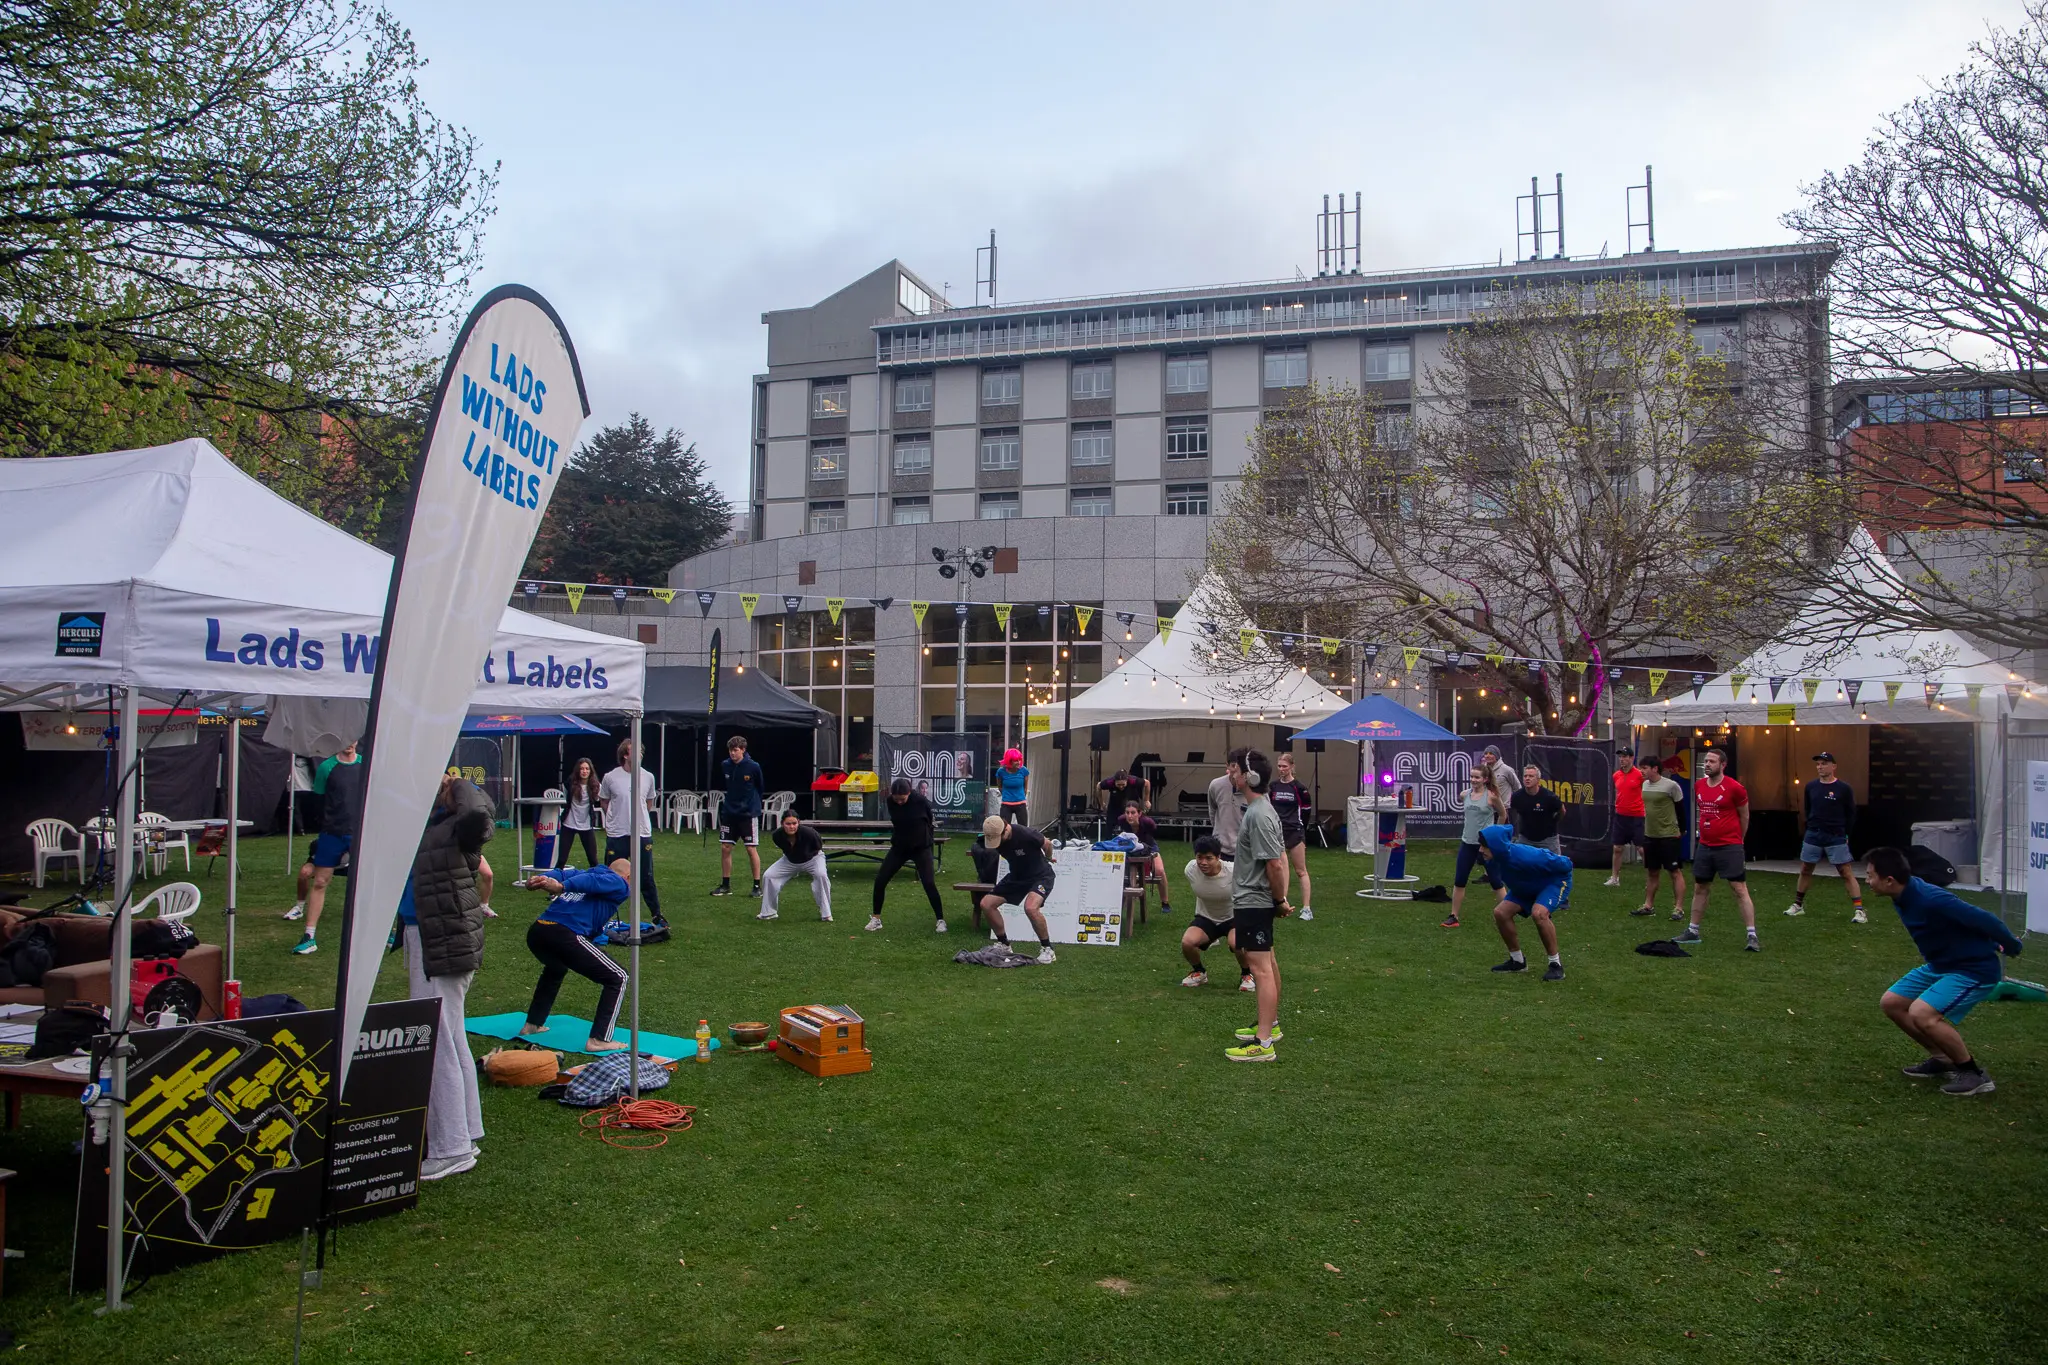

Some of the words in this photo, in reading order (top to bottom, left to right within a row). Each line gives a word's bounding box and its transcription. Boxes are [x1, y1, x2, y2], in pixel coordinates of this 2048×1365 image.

[491, 343, 547, 415] LADS
[461, 374, 559, 475] WITHOUT
[463, 431, 541, 510] LABELS
[60, 628, 100, 637] HERCULES
[205, 617, 325, 670] Lads
[507, 651, 609, 689] Labels
[166, 721, 196, 733] SOCIETY
[502, 720, 527, 728] Bull
[1350, 729, 1375, 737] Red
[1377, 729, 1401, 737] Bull
[891, 750, 954, 778] JOIN
[1393, 751, 1472, 782] FUN
[934, 779, 966, 806] US
[1421, 782, 1470, 812] RU
[538, 822, 553, 831] Bull
[358, 1024, 432, 1051] RUN72
[386, 1048, 411, 1056] WITHOUT
[411, 1045, 430, 1053] LABELS
[349, 1119, 381, 1132] COURSE
[382, 1116, 400, 1125] MAP
[334, 1137, 372, 1150] Distance:
[373, 1133, 396, 1143] 1.8km
[381, 1144, 413, 1156] C-Block
[333, 1166, 350, 1175] awn
[368, 1171, 404, 1184] welcome
[364, 1185, 397, 1203] JOIN
[400, 1181, 416, 1195] US
